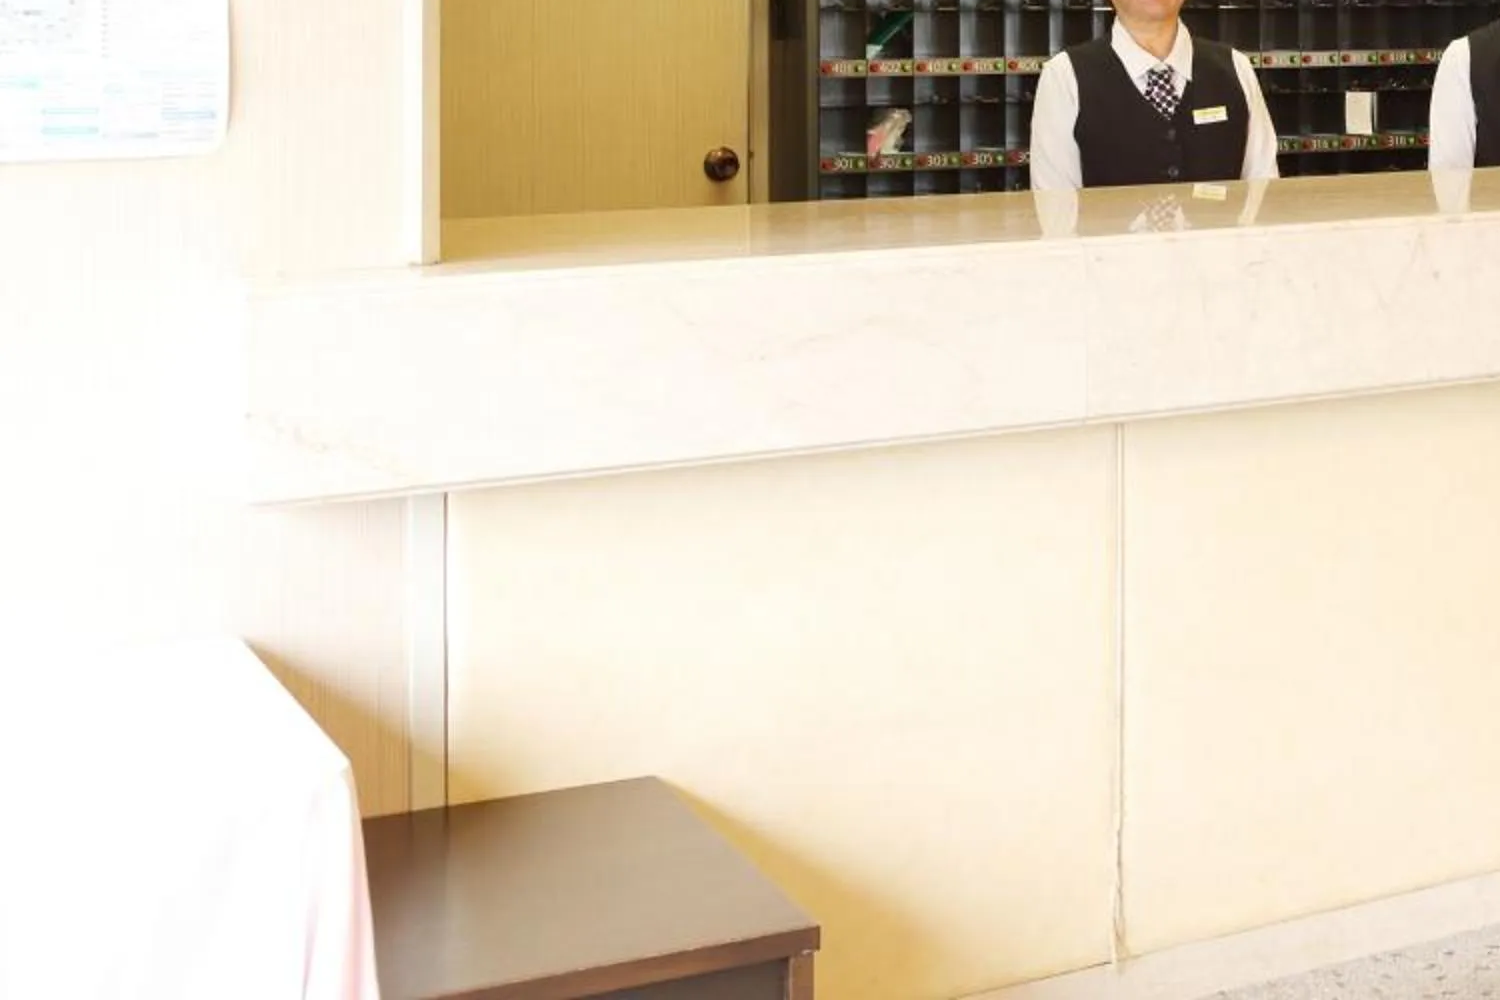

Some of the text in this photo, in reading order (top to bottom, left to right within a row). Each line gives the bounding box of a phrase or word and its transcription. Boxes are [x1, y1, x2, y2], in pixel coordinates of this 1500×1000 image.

[834, 157, 853, 170] 301
[880, 157, 901, 169] 302
[927, 154, 948, 166] 303
